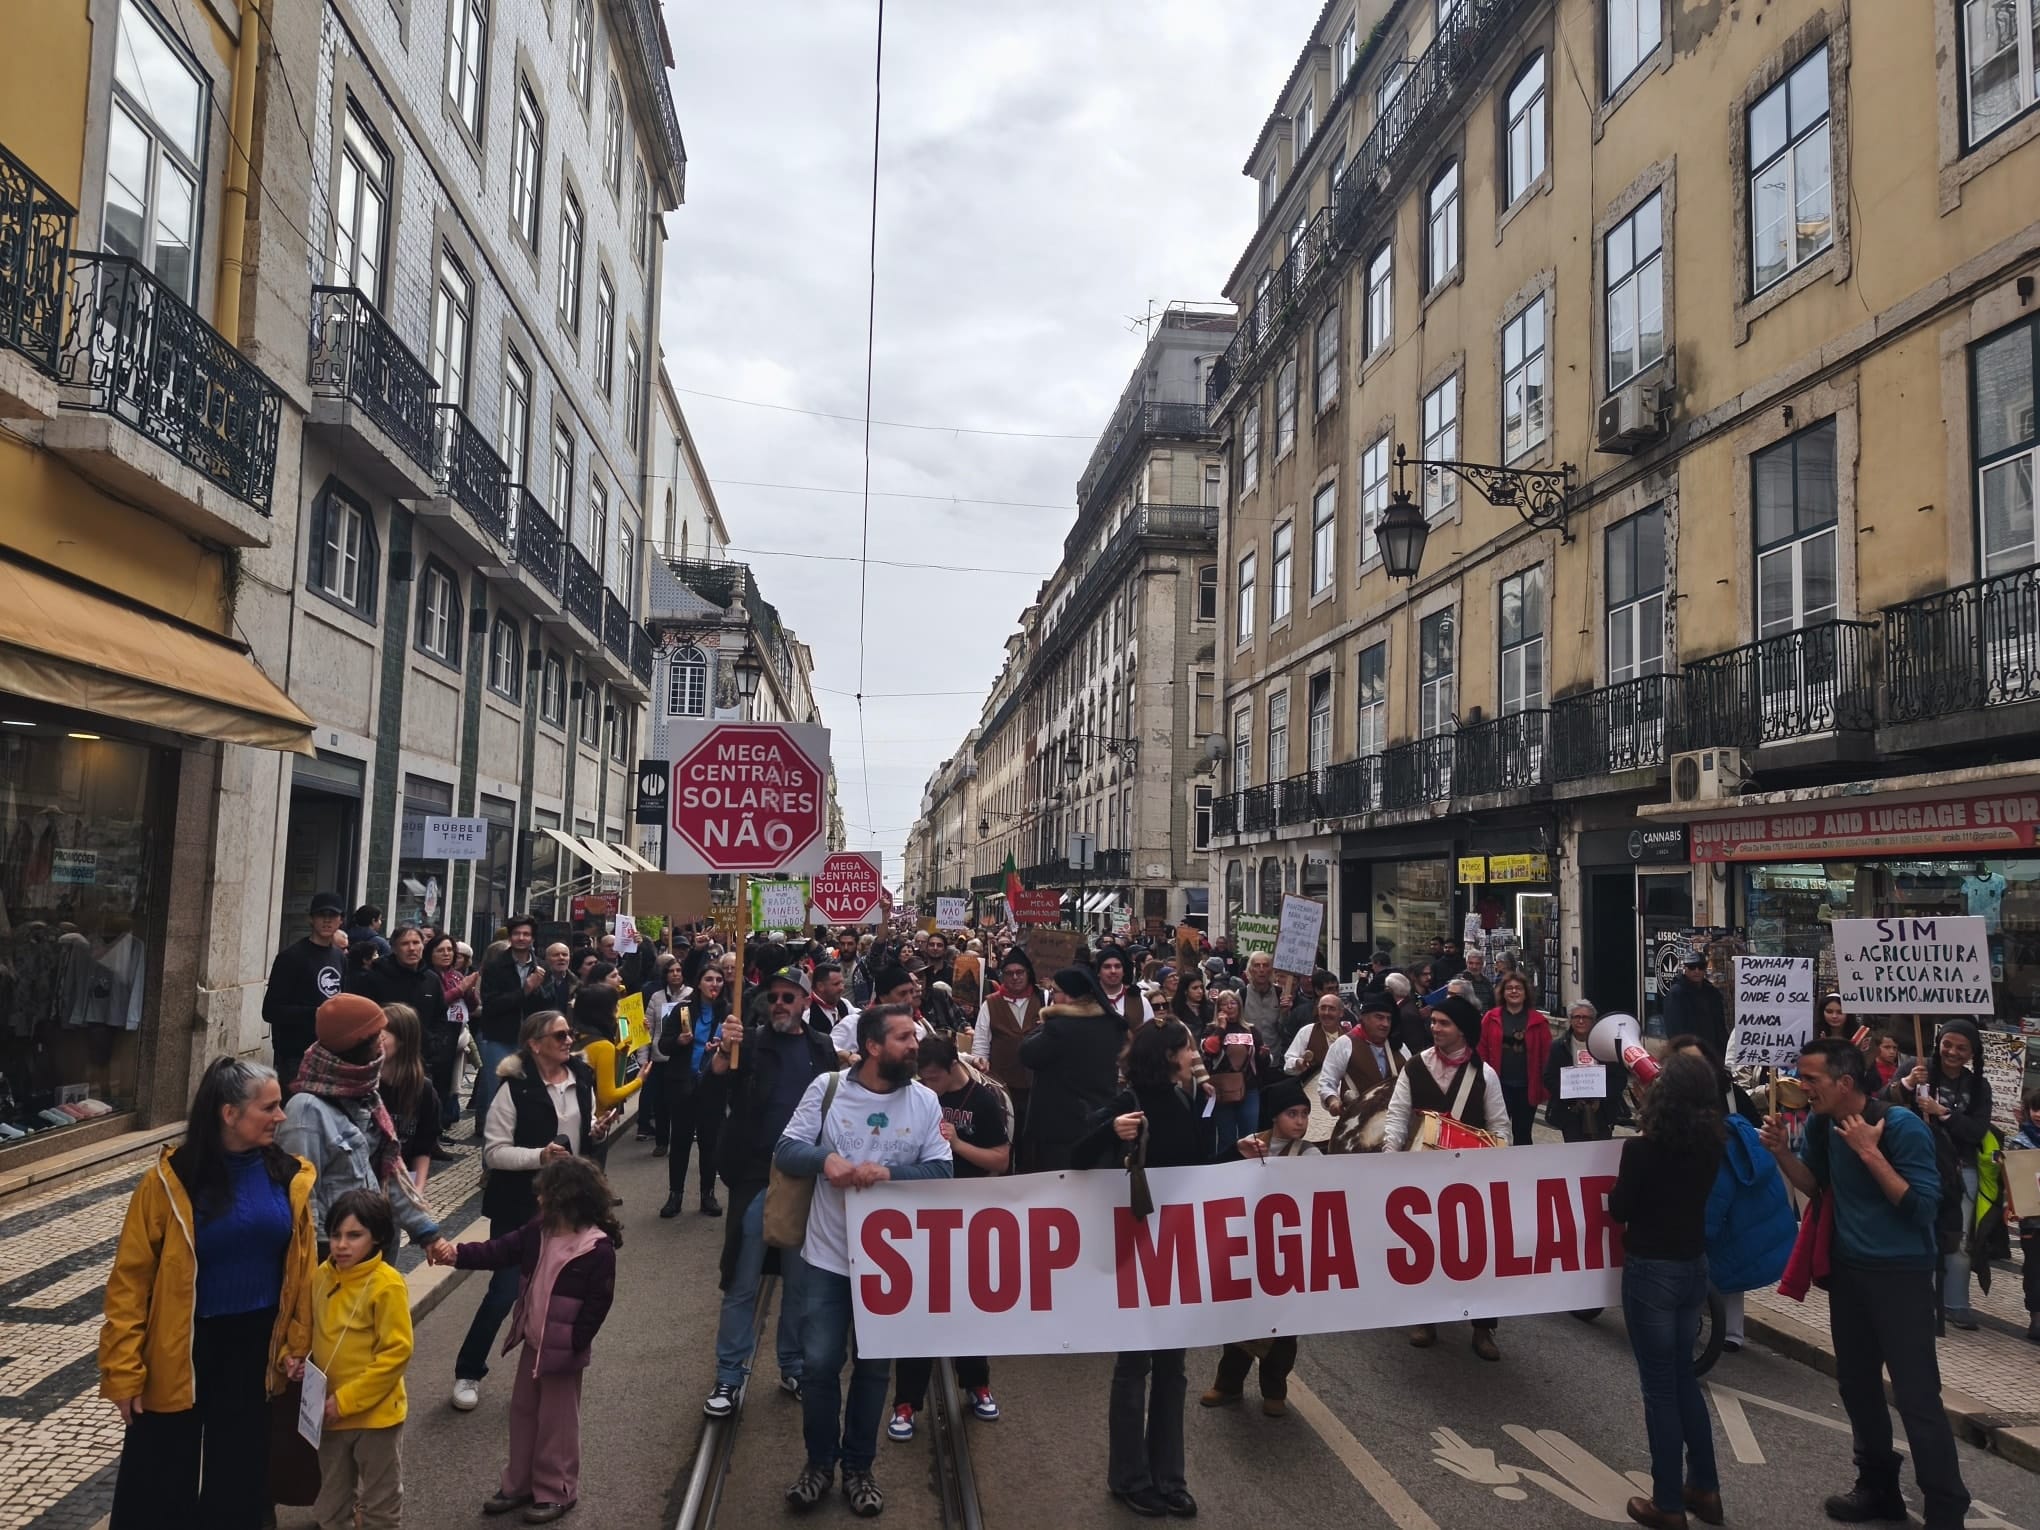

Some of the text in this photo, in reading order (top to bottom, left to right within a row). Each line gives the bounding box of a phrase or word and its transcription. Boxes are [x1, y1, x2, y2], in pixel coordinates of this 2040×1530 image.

[718, 744, 781, 762] MEGA
[690, 764, 803, 787] CENTRAIS
[683, 787, 813, 813] SOLARES
[1693, 797, 2040, 843] SOUVENIR SHOP AND LUGGAGE STOR
[703, 812, 793, 851] NÃO
[1644, 830, 1681, 844] CANNABIS
[830, 862, 861, 870] MEGA
[819, 872, 870, 880] CENTRAIS
[816, 882, 876, 893] SOLARES
[826, 894, 866, 912] NÃO
[1238, 922, 1278, 934] VANDALIS
[1876, 919, 1937, 942] SIM
[1859, 944, 1978, 963] AGRICULTURA
[1742, 958, 1809, 970] PONHAM A
[1740, 992, 1810, 1002] ONDE O SOL
[1858, 986, 1918, 1002] TURISMO
[1922, 986, 1990, 1004] NATUREZA
[1738, 1014, 1782, 1026] NUNCA
[860, 1175, 1625, 1317] STOP MEGA SOLAR
